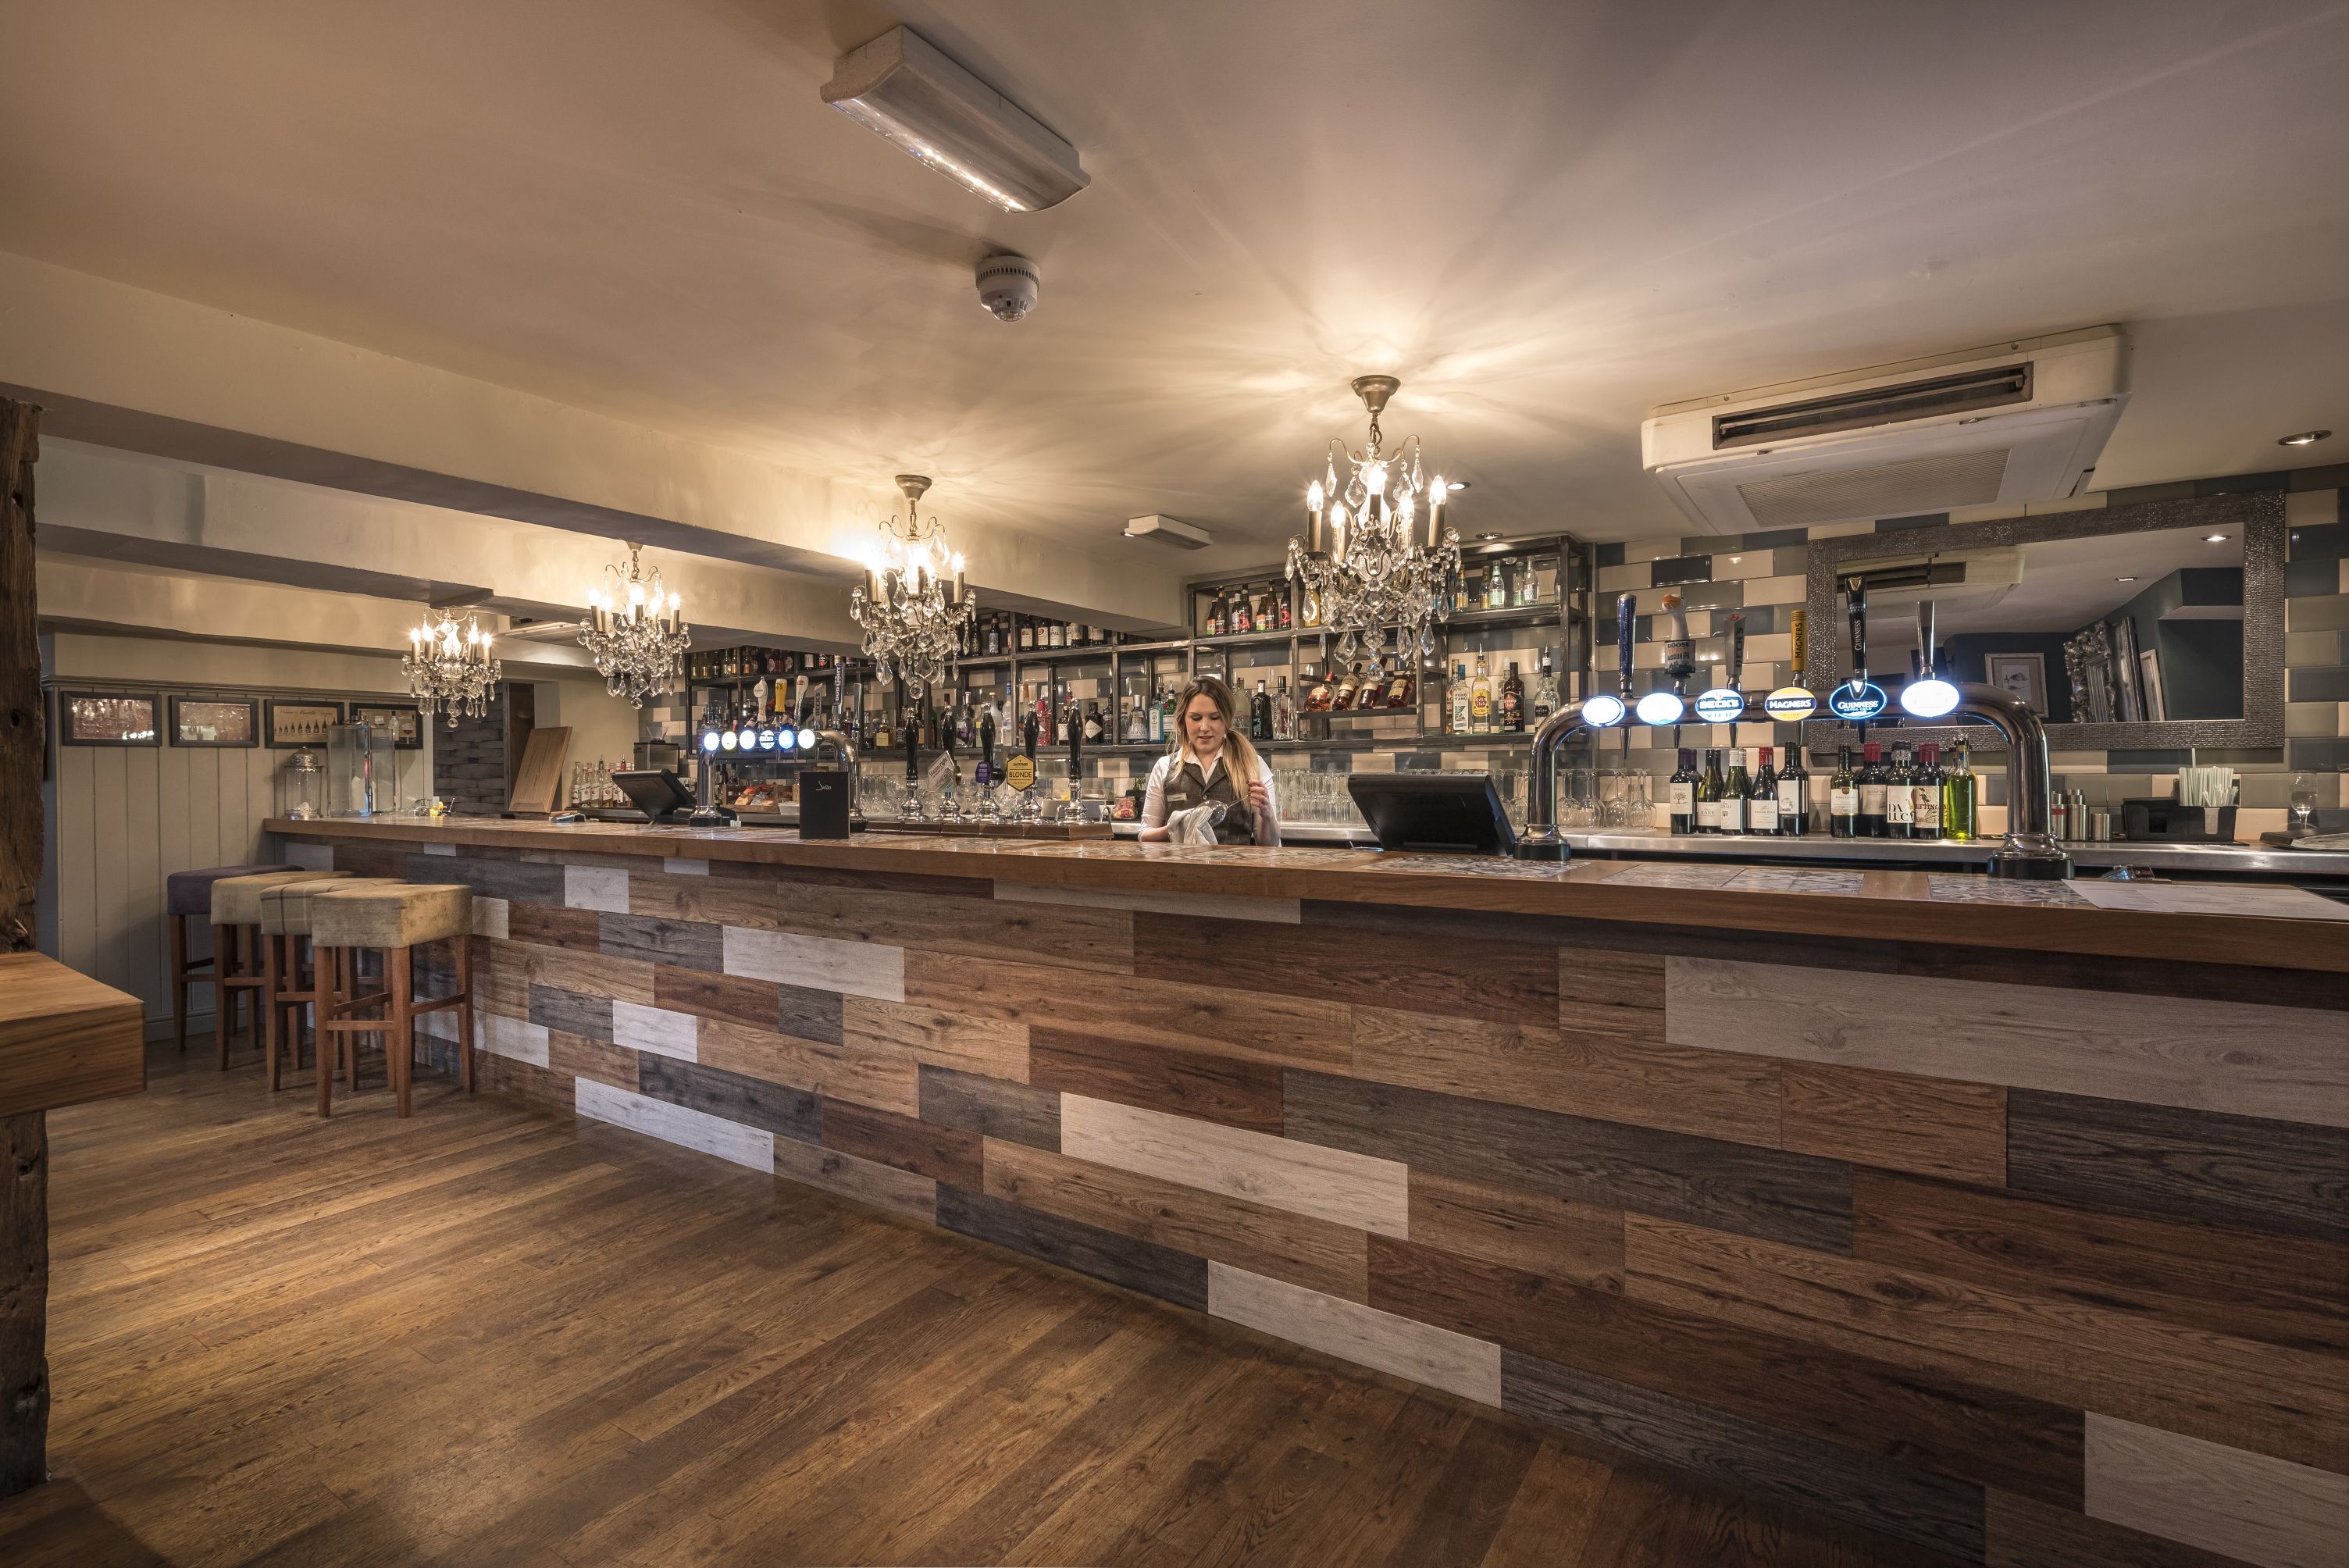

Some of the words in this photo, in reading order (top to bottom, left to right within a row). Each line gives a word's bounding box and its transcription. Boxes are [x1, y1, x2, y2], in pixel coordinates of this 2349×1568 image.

[1769, 699, 1812, 709] MAGNERS
[1837, 700, 1879, 710] GUINNESS
[1888, 804, 1903, 812] DA
